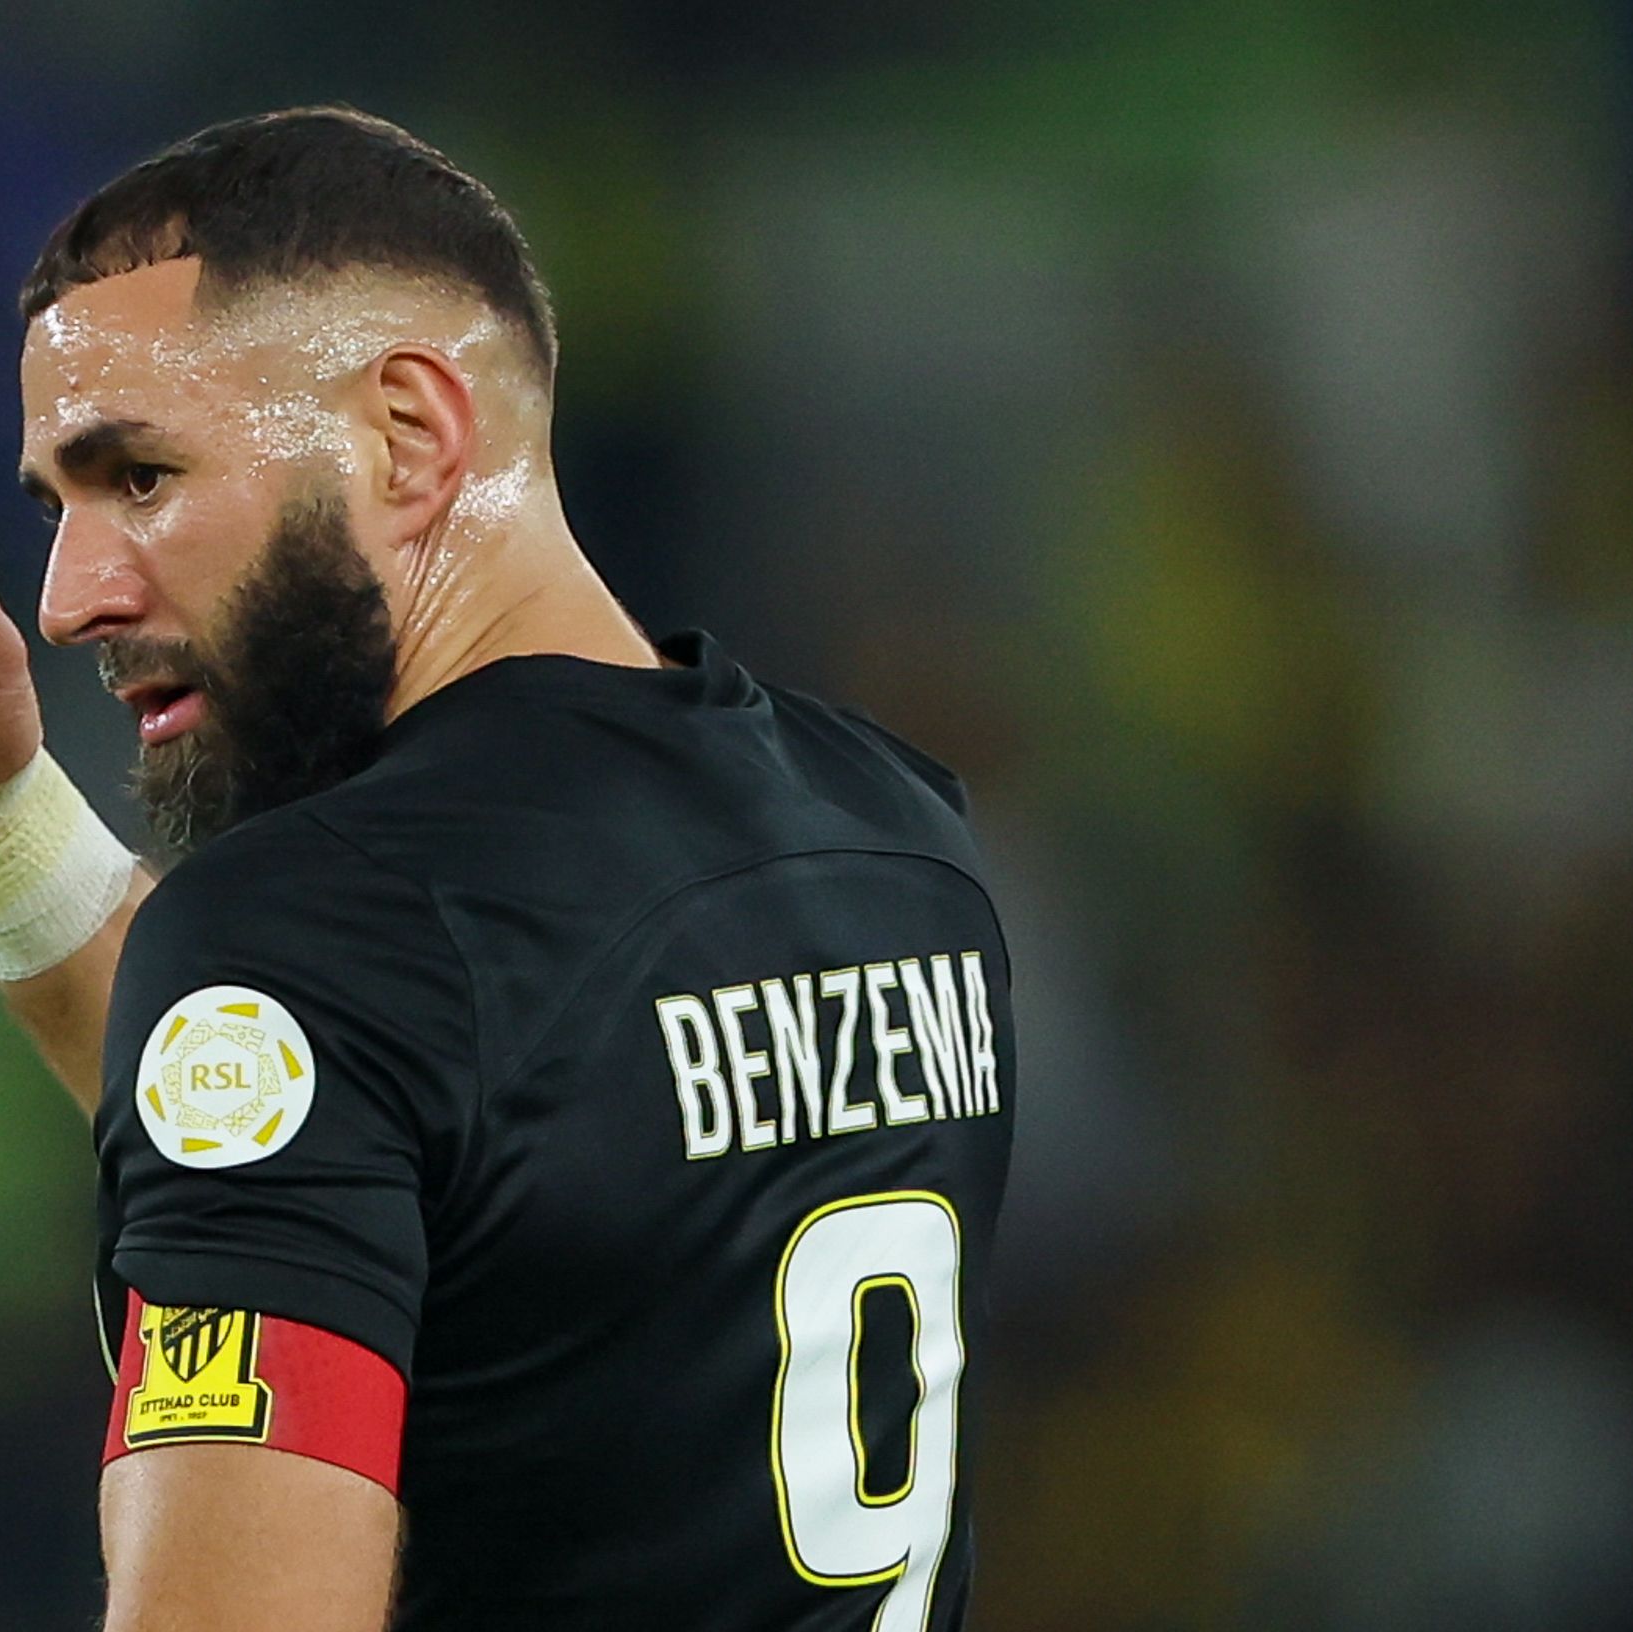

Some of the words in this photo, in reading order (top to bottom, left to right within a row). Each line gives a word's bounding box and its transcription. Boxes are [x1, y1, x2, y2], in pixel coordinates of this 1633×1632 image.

[655, 951, 1000, 1161] BENZEMA
[190, 1062, 252, 1092] RSL
[199, 1393, 241, 1407] CLUB
